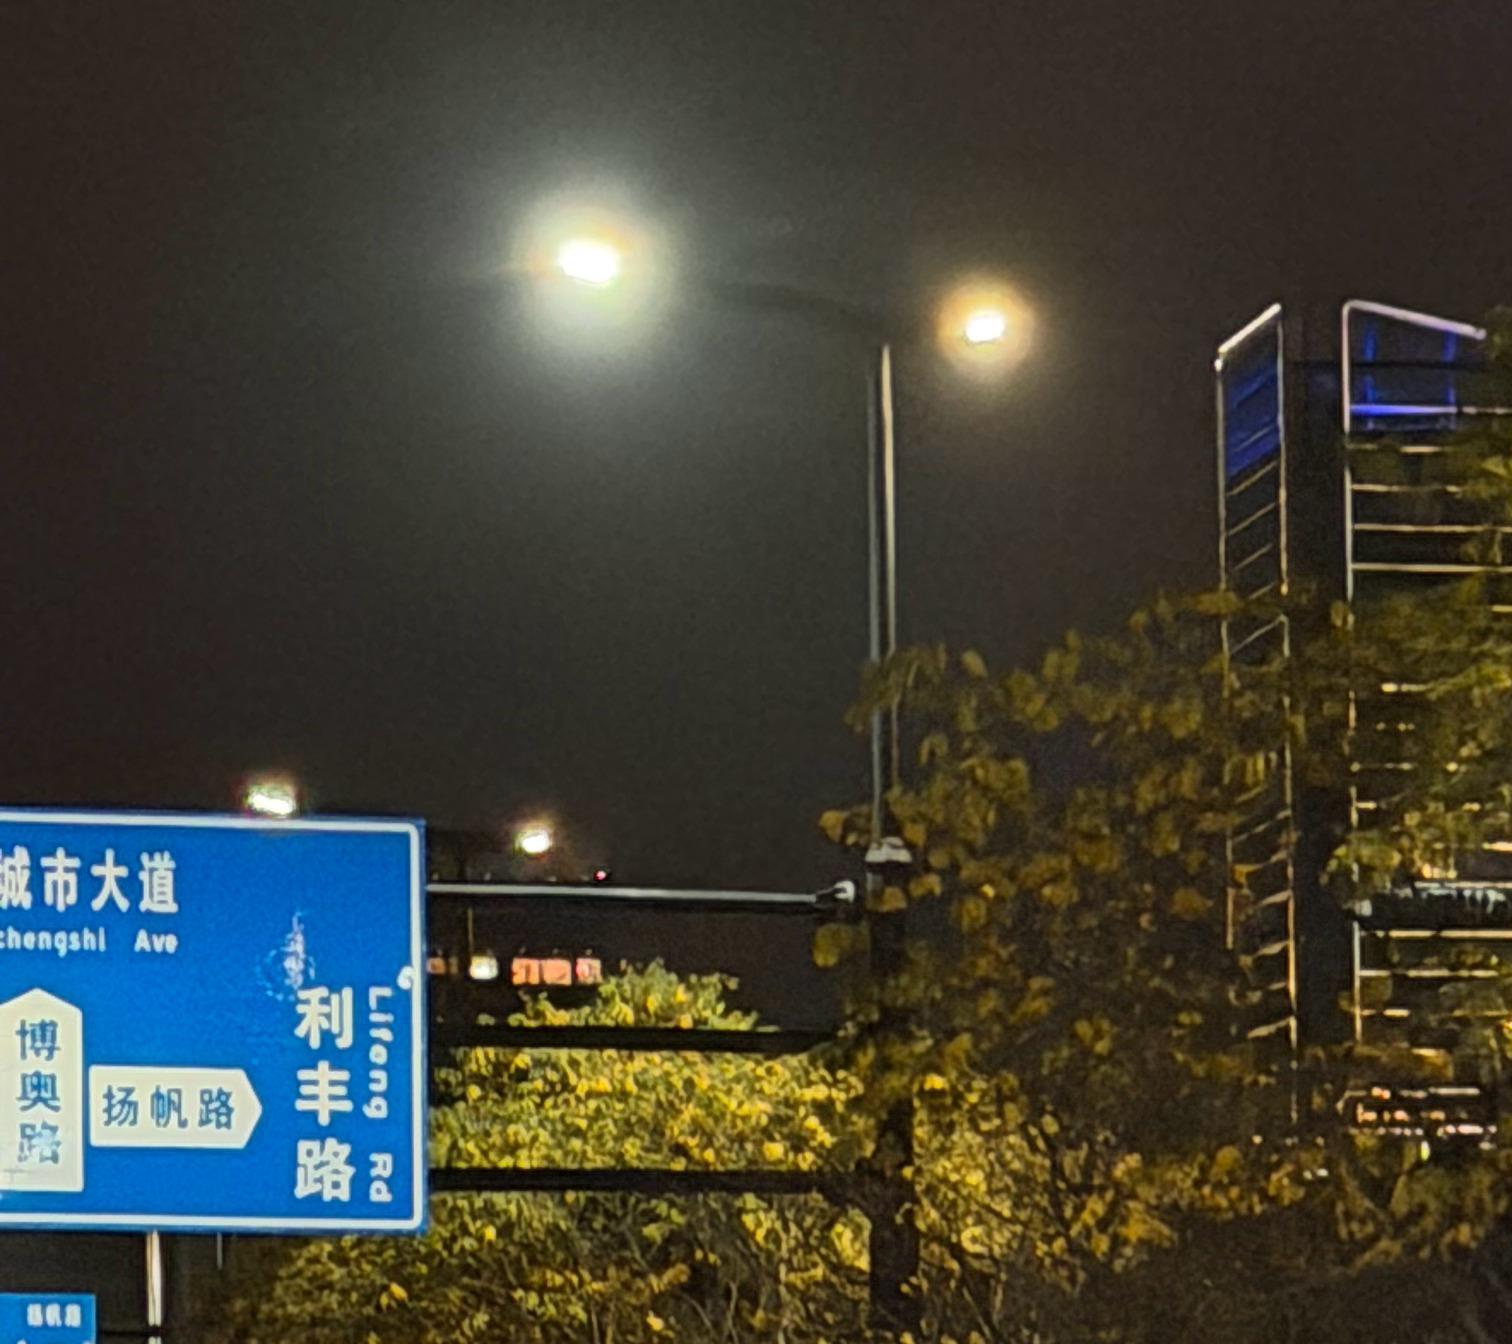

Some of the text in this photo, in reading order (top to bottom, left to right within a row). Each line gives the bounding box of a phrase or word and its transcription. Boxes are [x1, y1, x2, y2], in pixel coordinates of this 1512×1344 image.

[0, 845, 179, 913] 城市大道
[135, 928, 178, 954] Ave
[102, 1084, 235, 1130] 扬帆路
[294, 986, 356, 1202] 利丰路
[369, 1152, 393, 1202] Rd
